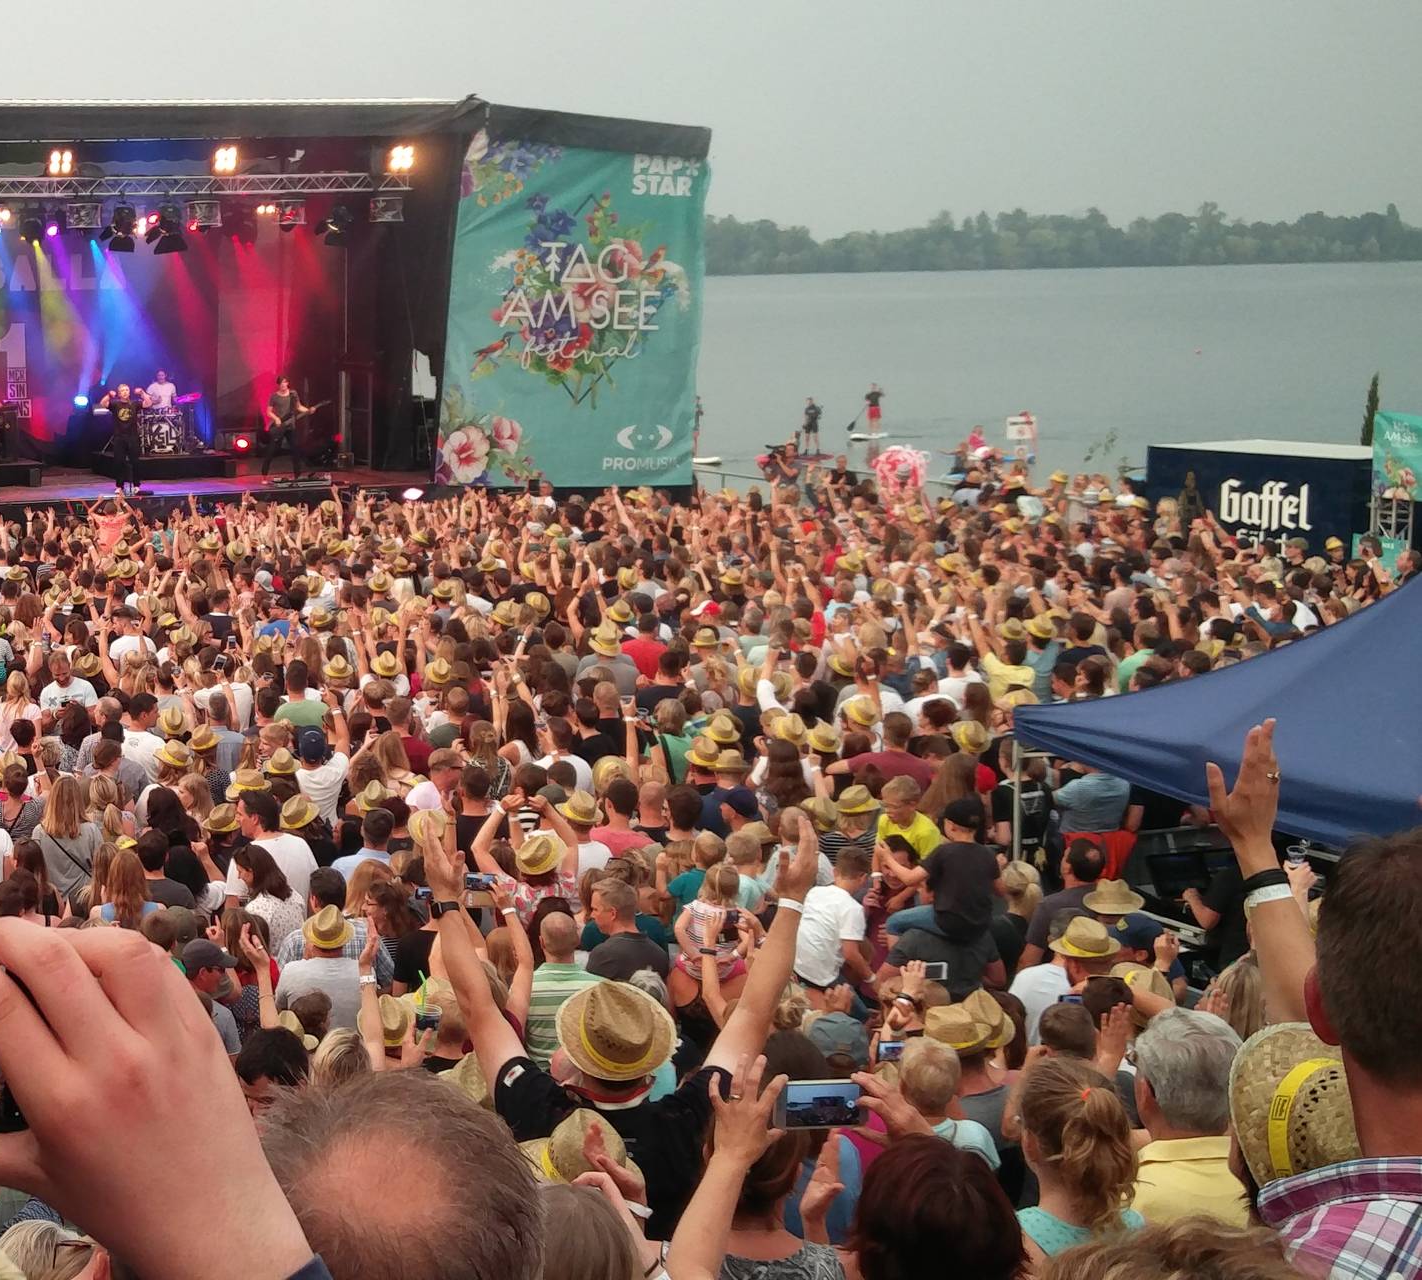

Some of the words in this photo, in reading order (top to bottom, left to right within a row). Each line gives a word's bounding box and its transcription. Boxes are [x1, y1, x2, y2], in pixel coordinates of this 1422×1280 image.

[633, 154, 681, 175] PAP
[631, 175, 692, 197] STAR
[540, 242, 629, 284] TAG
[499, 290, 576, 330] AM
[588, 290, 661, 331] SEE
[520, 332, 640, 368] festival
[9, 383, 25, 398] SIN
[1220, 479, 1312, 532] Gaffel
